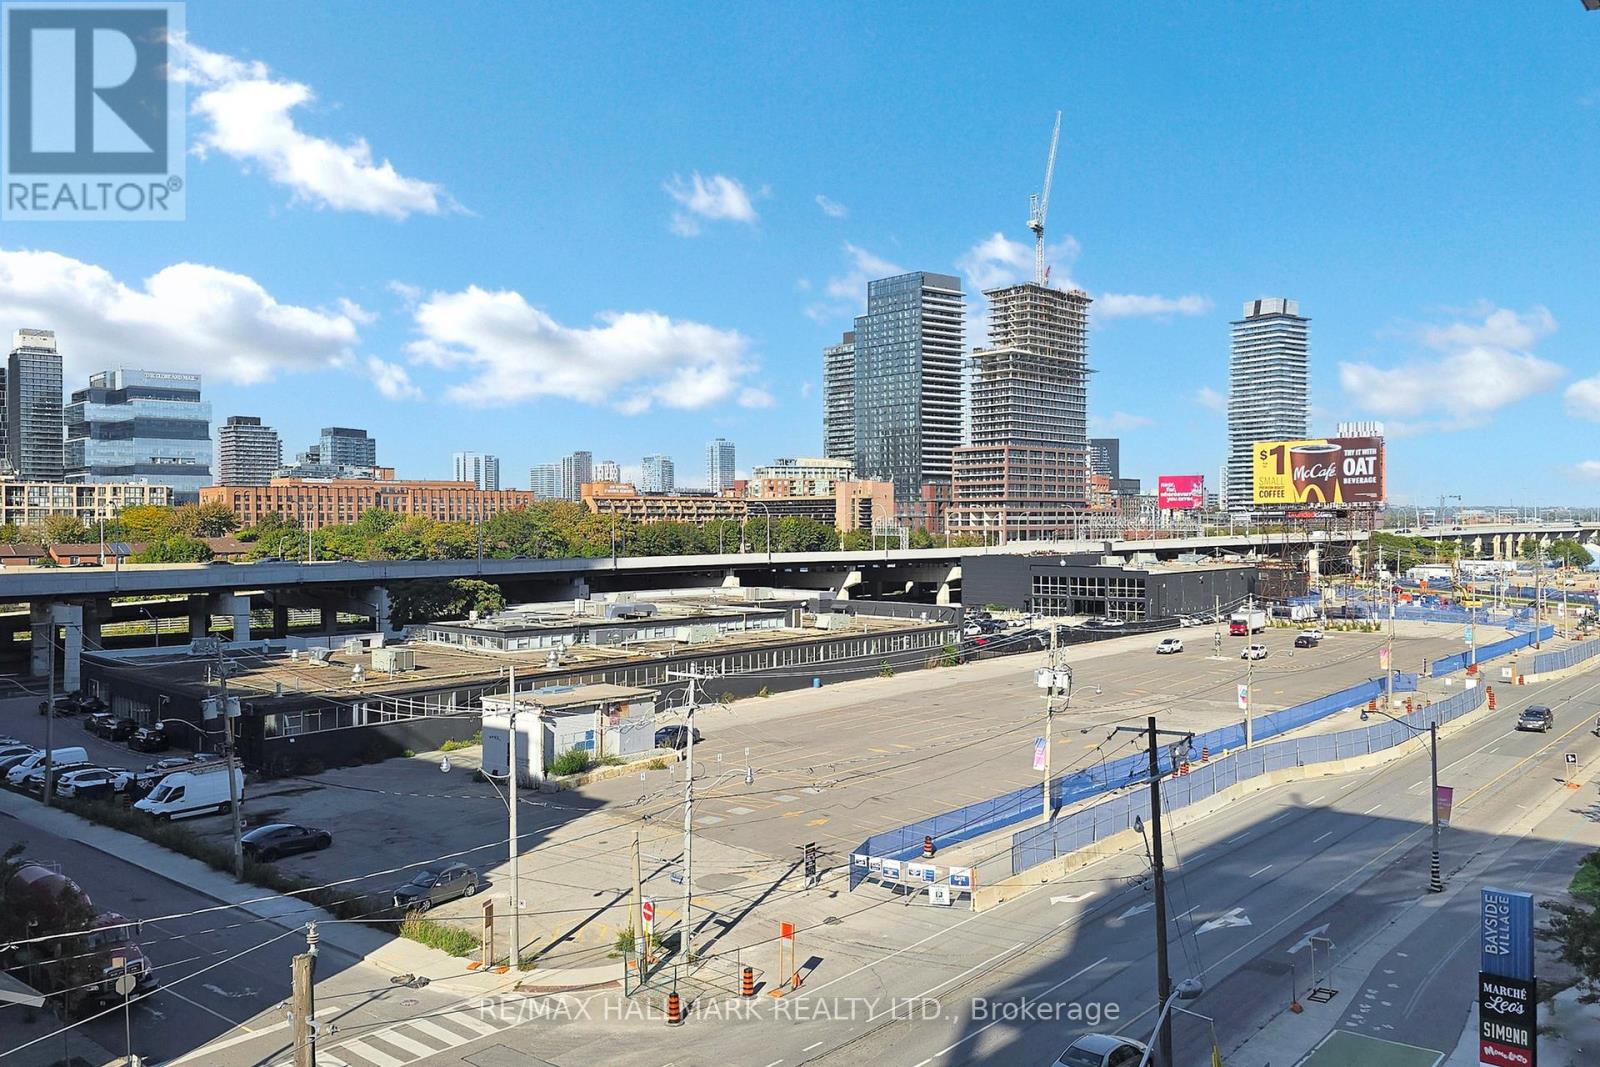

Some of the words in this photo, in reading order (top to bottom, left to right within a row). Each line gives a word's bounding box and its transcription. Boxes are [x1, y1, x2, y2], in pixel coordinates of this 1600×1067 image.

[1260, 445, 1285, 475] $1
[1343, 456, 1377, 476] OAT
[1259, 477, 1284, 485] SMALL
[1343, 476, 1377, 484] BEVERAGE
[1259, 490, 1285, 498] COFFEE
[1484, 894, 1498, 955] BAYSIDE
[1499, 895, 1510, 955] VILLAGE
[1483, 982, 1527, 1000] MARCHÉ
[1484, 996, 1525, 1015] Leo's
[1483, 1021, 1528, 1047] SIMONA
